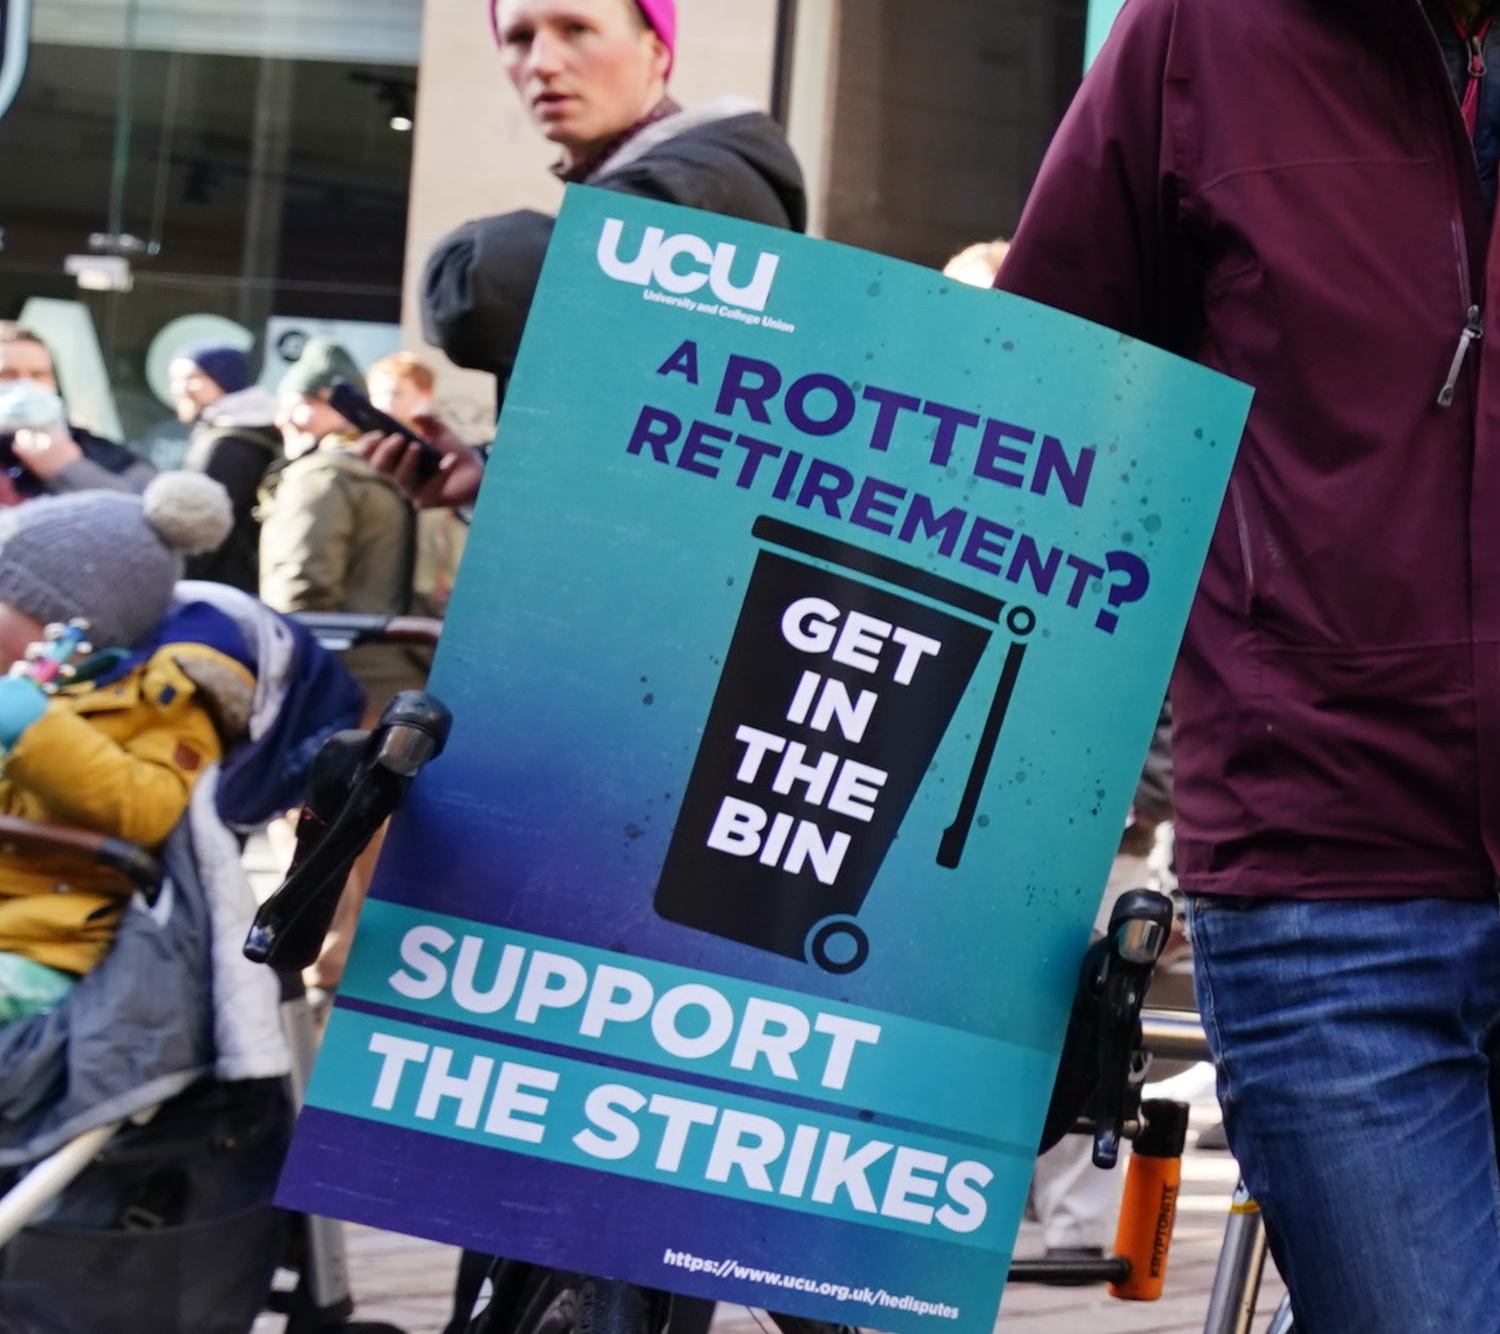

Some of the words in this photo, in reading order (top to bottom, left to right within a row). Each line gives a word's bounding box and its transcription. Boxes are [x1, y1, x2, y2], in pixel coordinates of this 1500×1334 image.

[597, 217, 780, 312] UCU
[642, 287, 697, 312] University
[696, 302, 719, 316] and
[718, 305, 760, 326] College
[762, 314, 795, 334] Union
[656, 339, 699, 385] A
[714, 353, 1096, 508] ROTTEN
[626, 404, 1150, 634] RETIREMENT?
[781, 596, 942, 686] GET
[786, 669, 878, 743] IN
[735, 724, 888, 822] THE
[706, 794, 852, 885] BIN
[388, 924, 882, 1091] SUPPORT
[367, 1032, 560, 1144] THE
[571, 1083, 995, 1234] STRIKES
[1149, 1183, 1175, 1278] KRYPTONITE
[662, 1247, 960, 1322] https://www.ucu.org.uk/hedisputes
